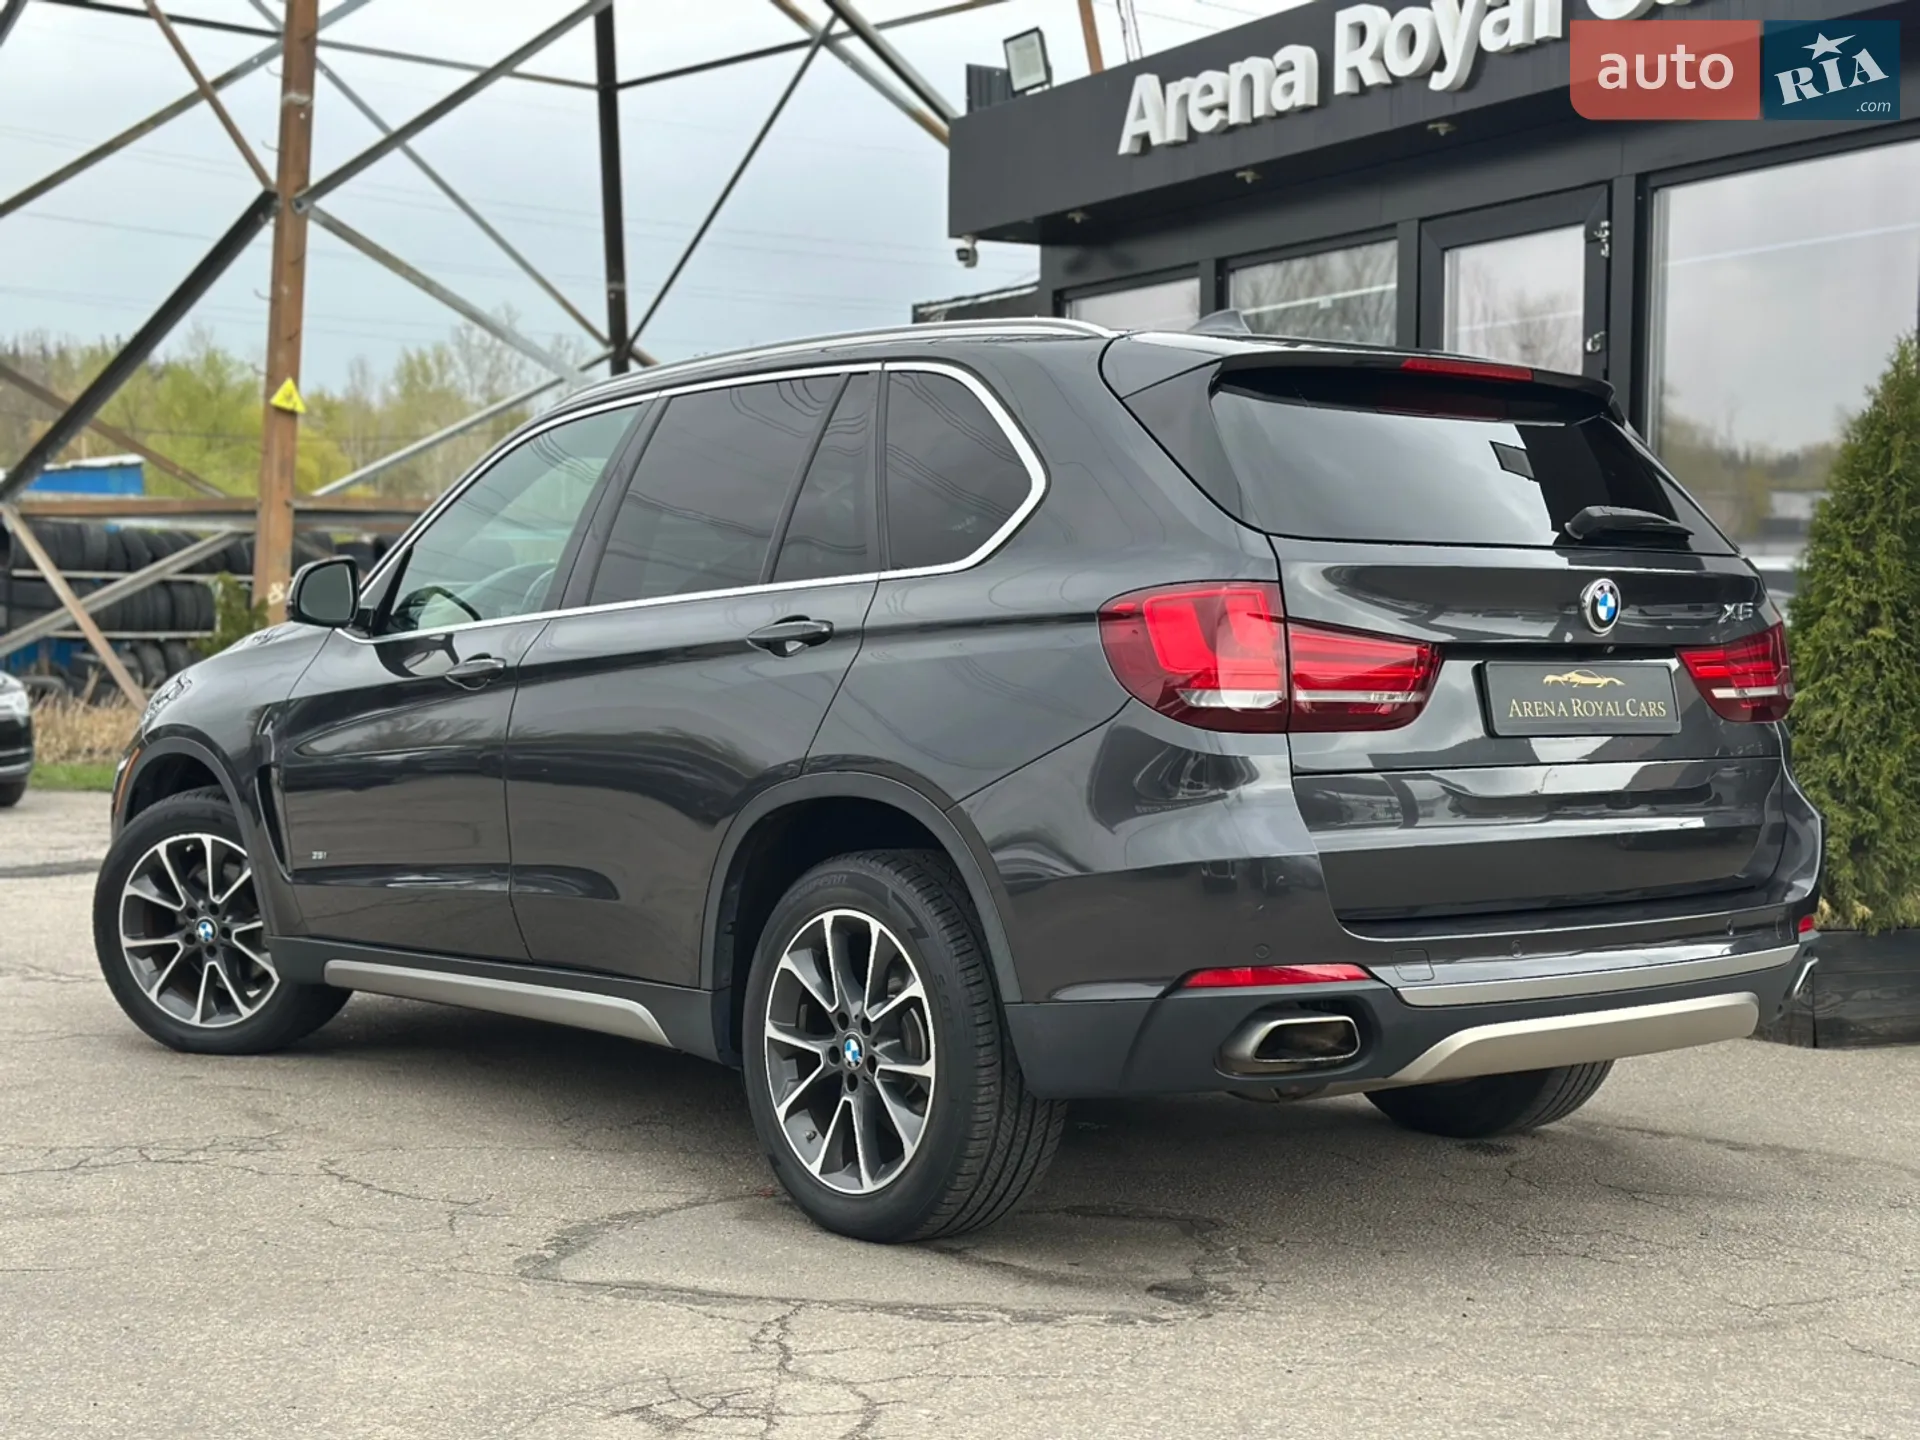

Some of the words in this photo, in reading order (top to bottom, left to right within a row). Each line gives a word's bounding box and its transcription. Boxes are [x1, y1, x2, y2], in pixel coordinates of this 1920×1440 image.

[1117, 43, 1319, 156] Arena
[1508, 698, 1569, 718] ARENA
[1570, 697, 1625, 718] ROYAL
[1625, 697, 1667, 718] CARS
